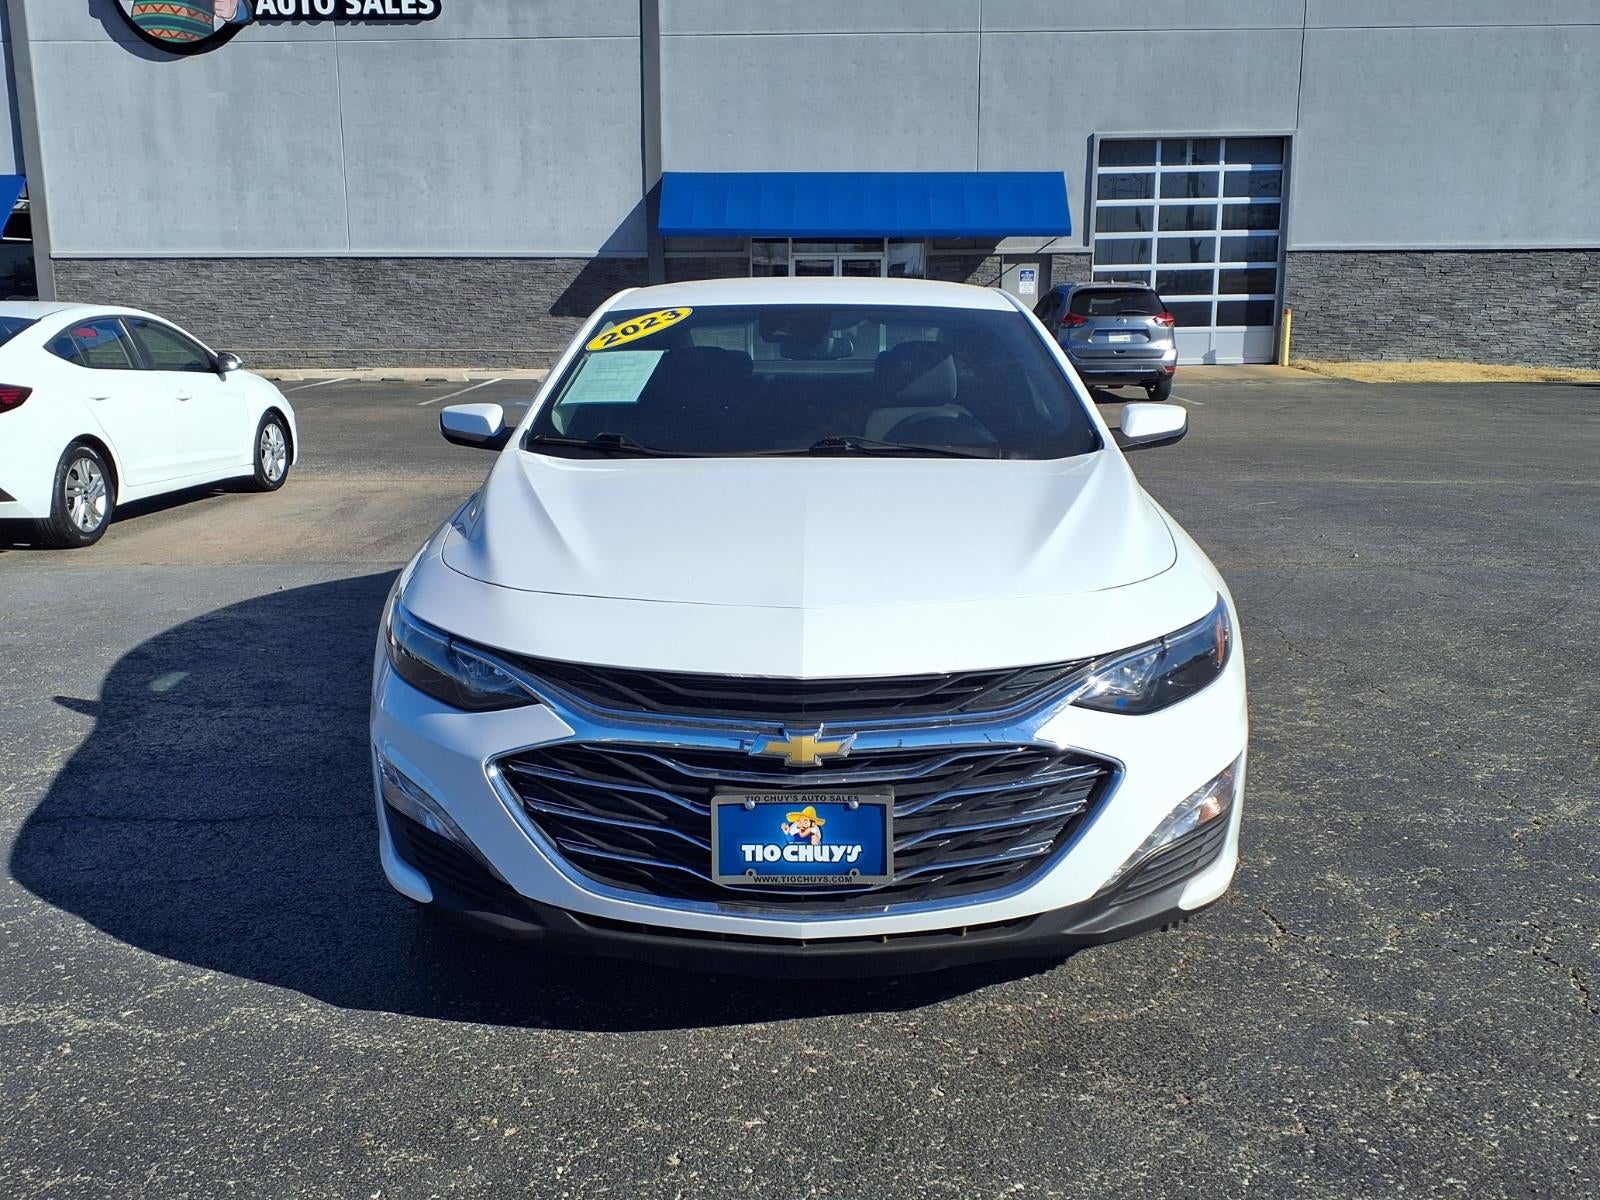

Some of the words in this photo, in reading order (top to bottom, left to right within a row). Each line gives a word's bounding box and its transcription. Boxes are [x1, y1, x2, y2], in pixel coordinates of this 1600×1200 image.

[255, 0, 335, 15] AUTO
[345, 0, 435, 15] SALES
[599, 310, 683, 346] 2023
[741, 844, 781, 862] TIO
